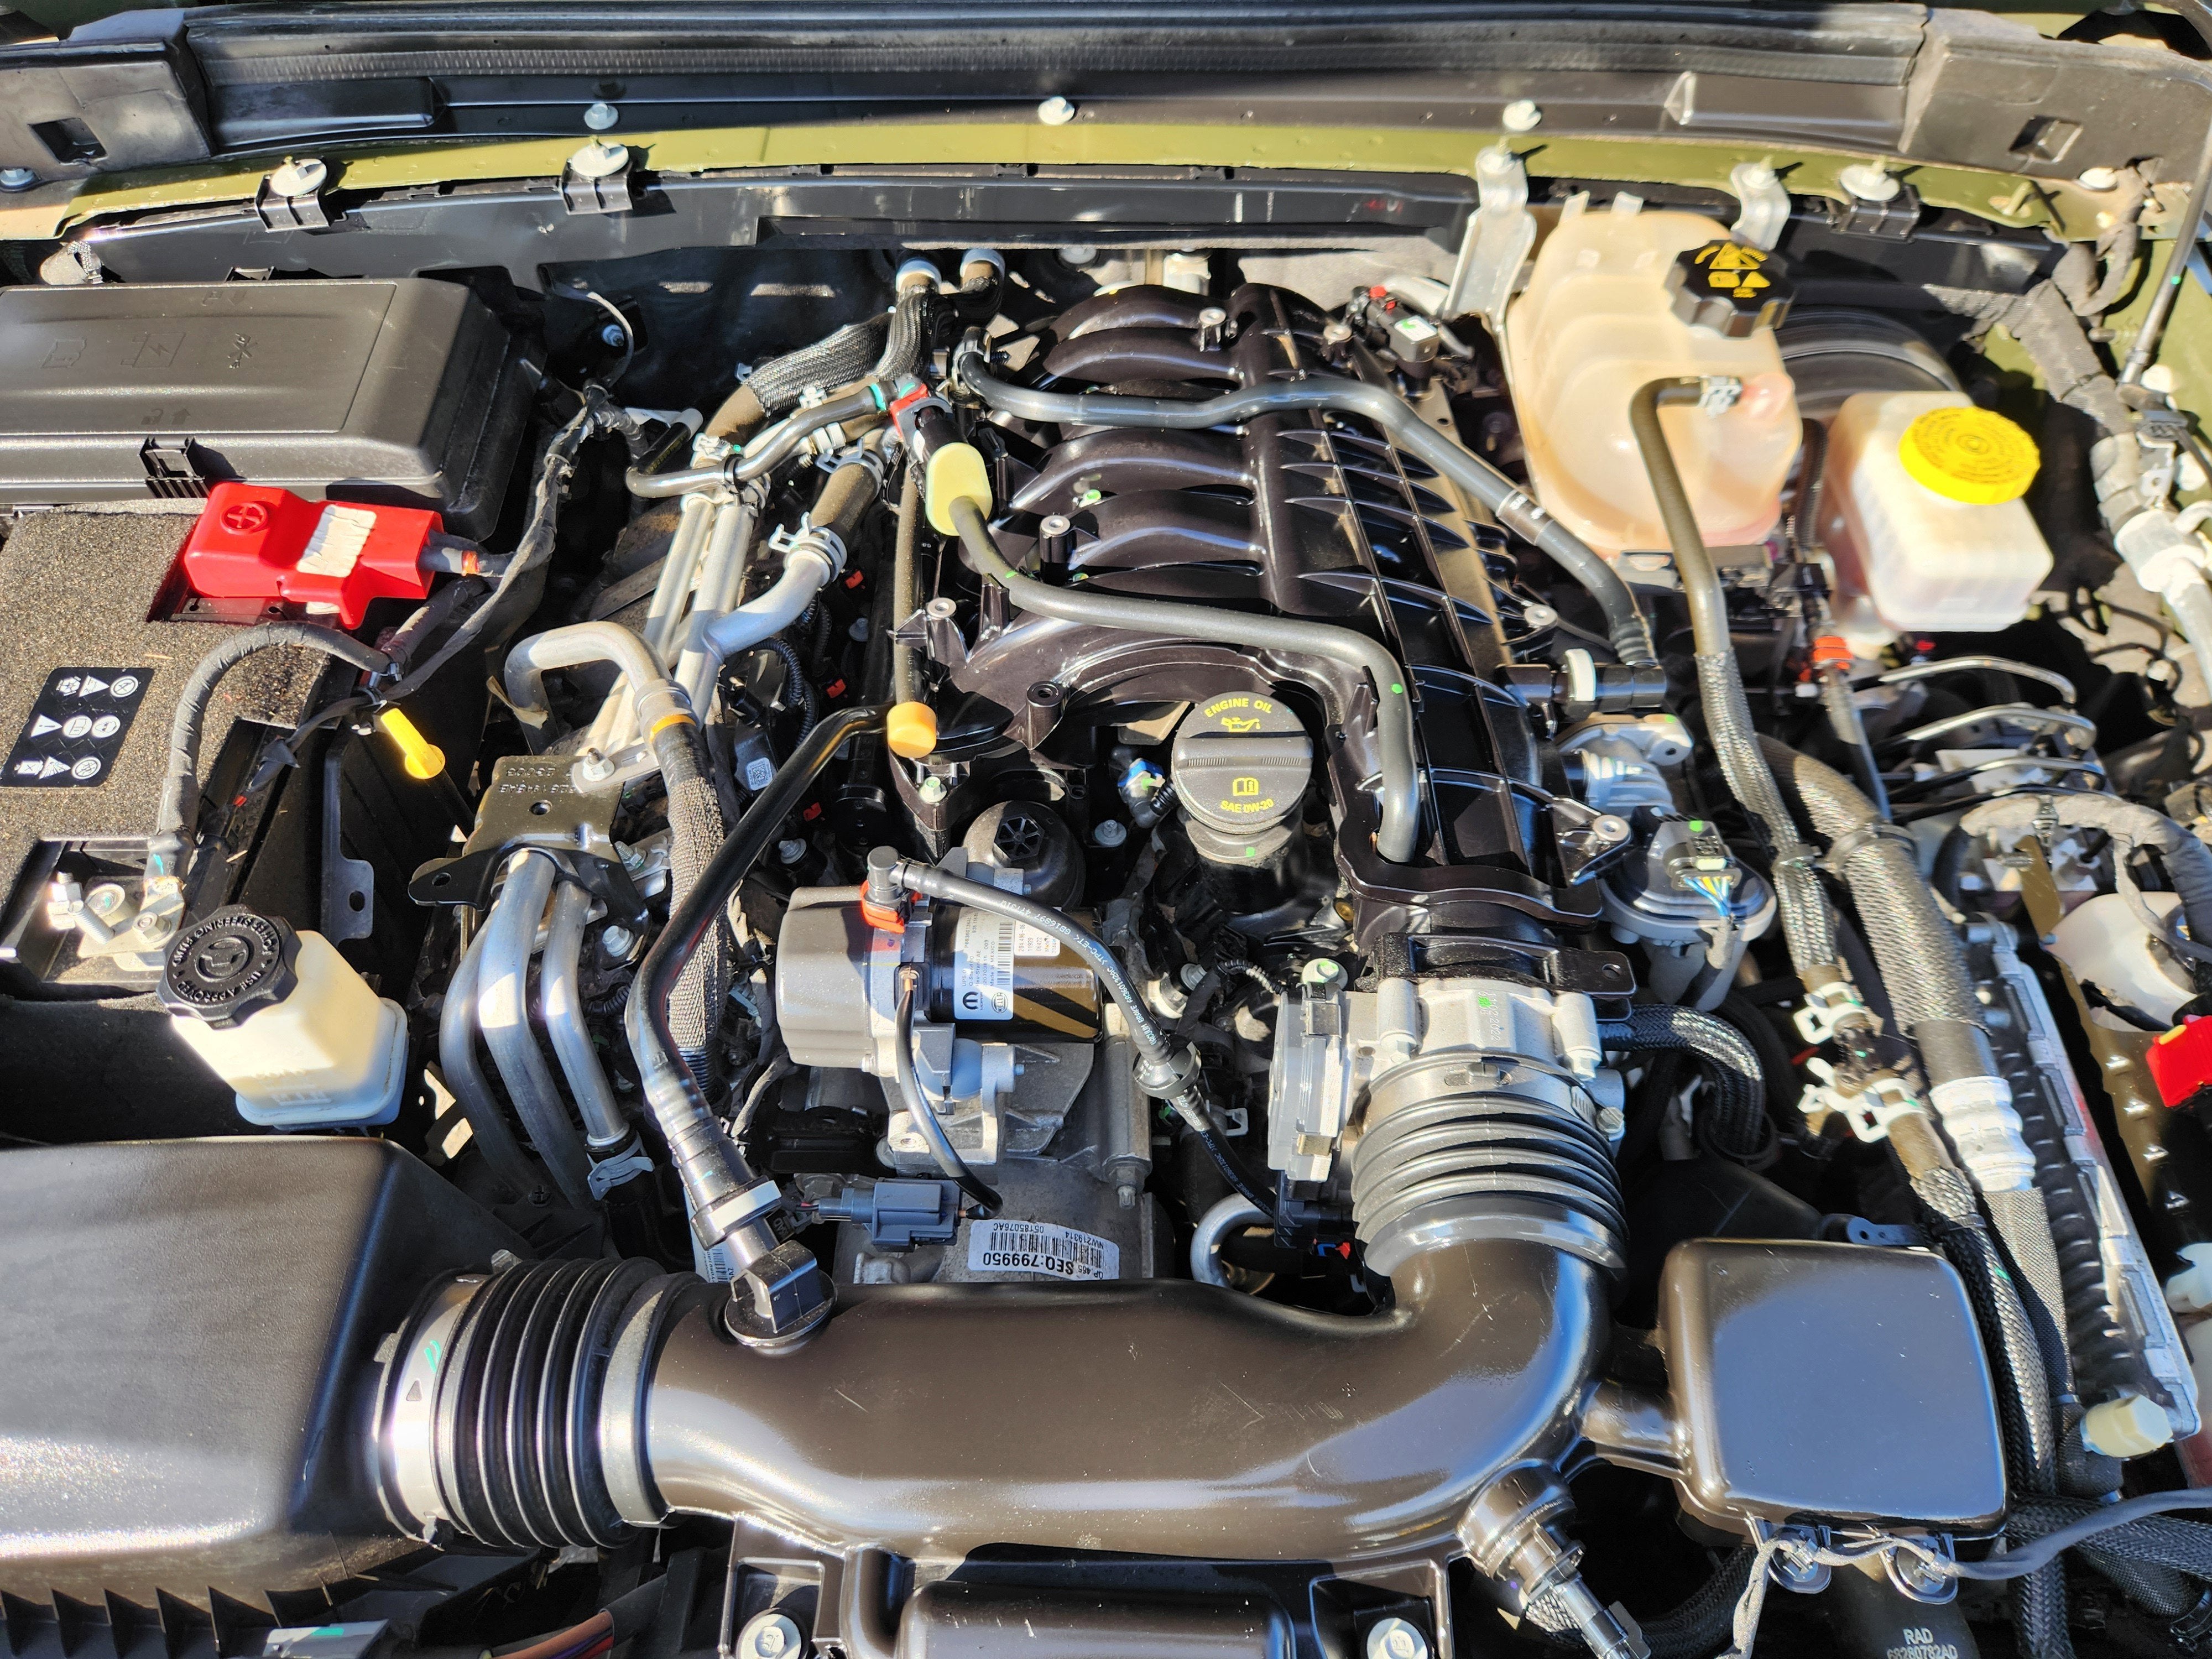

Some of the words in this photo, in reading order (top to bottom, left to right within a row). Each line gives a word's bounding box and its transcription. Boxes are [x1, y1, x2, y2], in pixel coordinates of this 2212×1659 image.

[1204, 697, 1249, 718] ENGINE
[1254, 699, 1272, 714] OIL
[1220, 800, 1242, 813] SAE
[1243, 798, 1274, 813] 0W-20
[194, 916, 251, 938] STEERING
[176, 980, 236, 1003] APPROVED
[1130, 1005, 1145, 1024] BRAKE
[1140, 1023, 1157, 1045] VACUUM
[1235, 1182, 1254, 1199] BRAKE
[983, 1253, 1074, 1275] SEQ:799950
[1903, 1627, 1933, 1645] RAD
